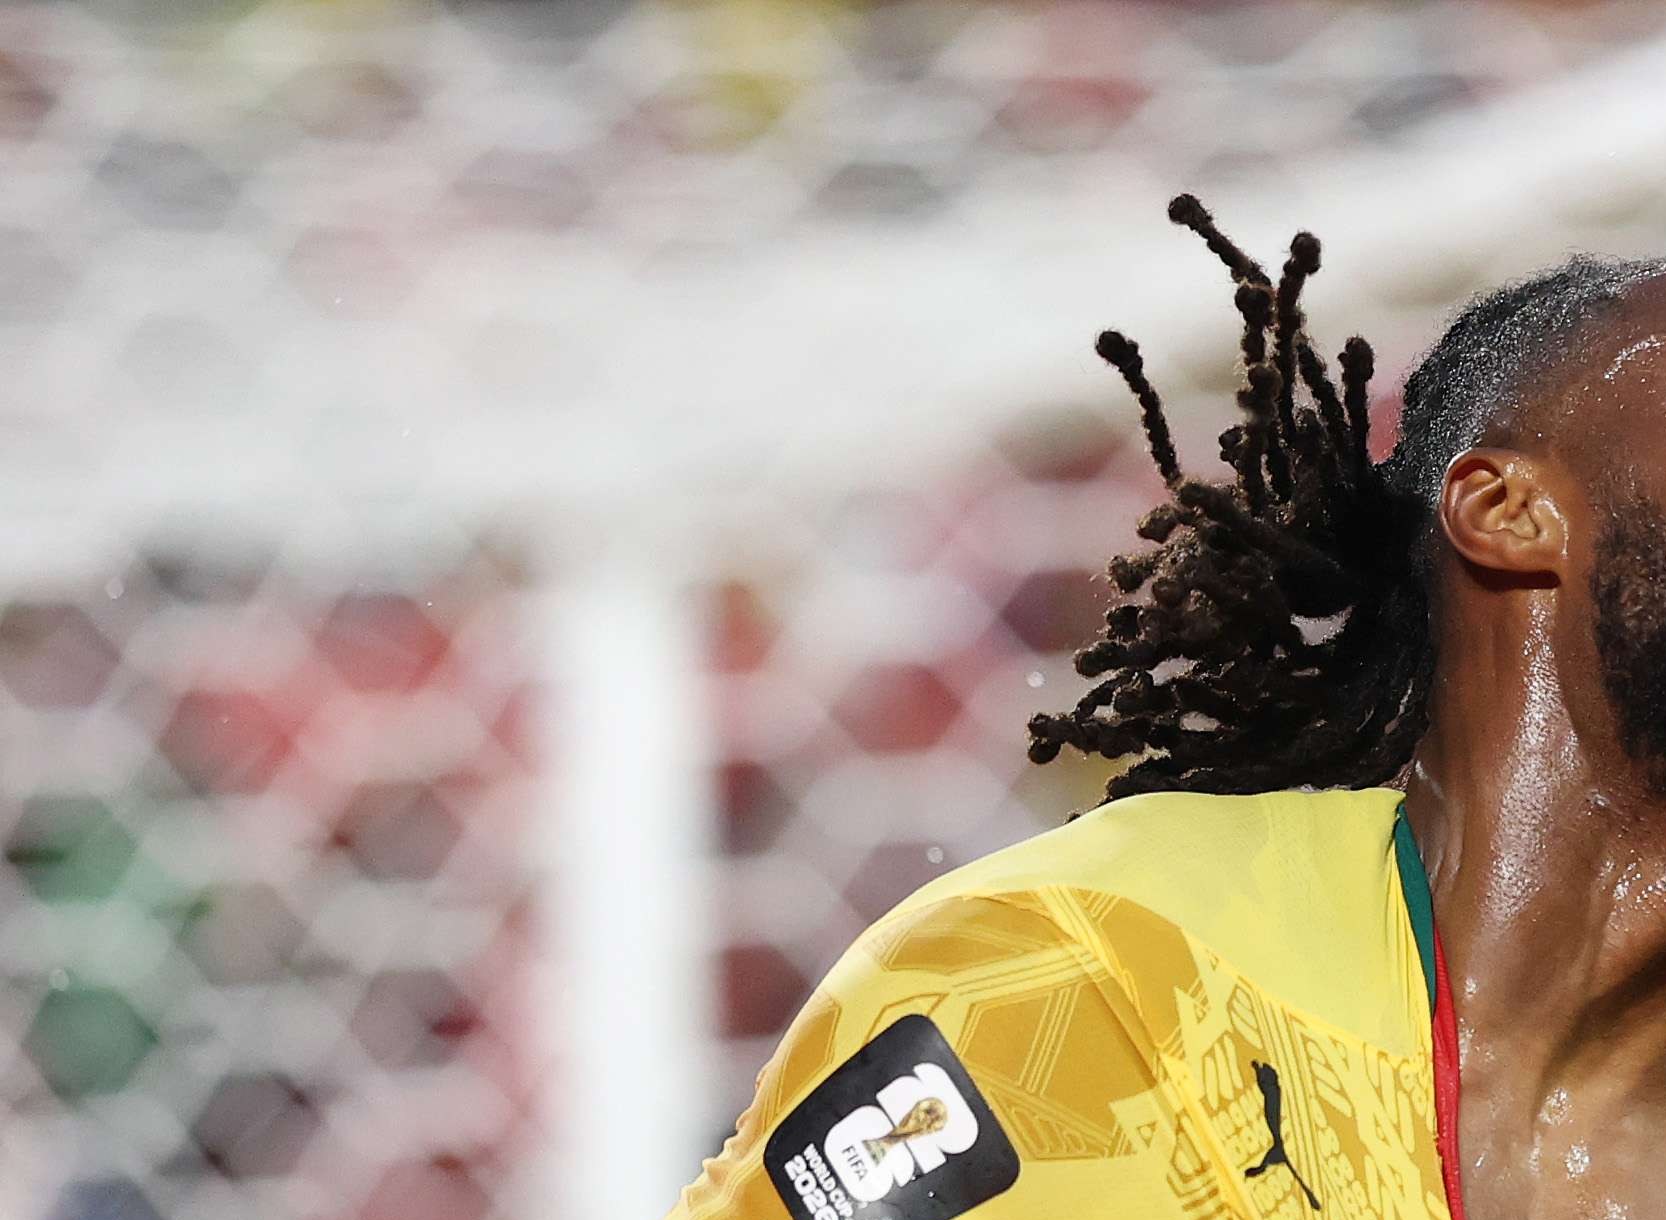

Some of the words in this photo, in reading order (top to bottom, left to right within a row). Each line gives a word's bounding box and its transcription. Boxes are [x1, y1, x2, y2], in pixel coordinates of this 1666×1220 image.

[803, 1143, 836, 1192] WORLD
[829, 1187, 853, 1217] CUP
[841, 1145, 868, 1182] FIFA
